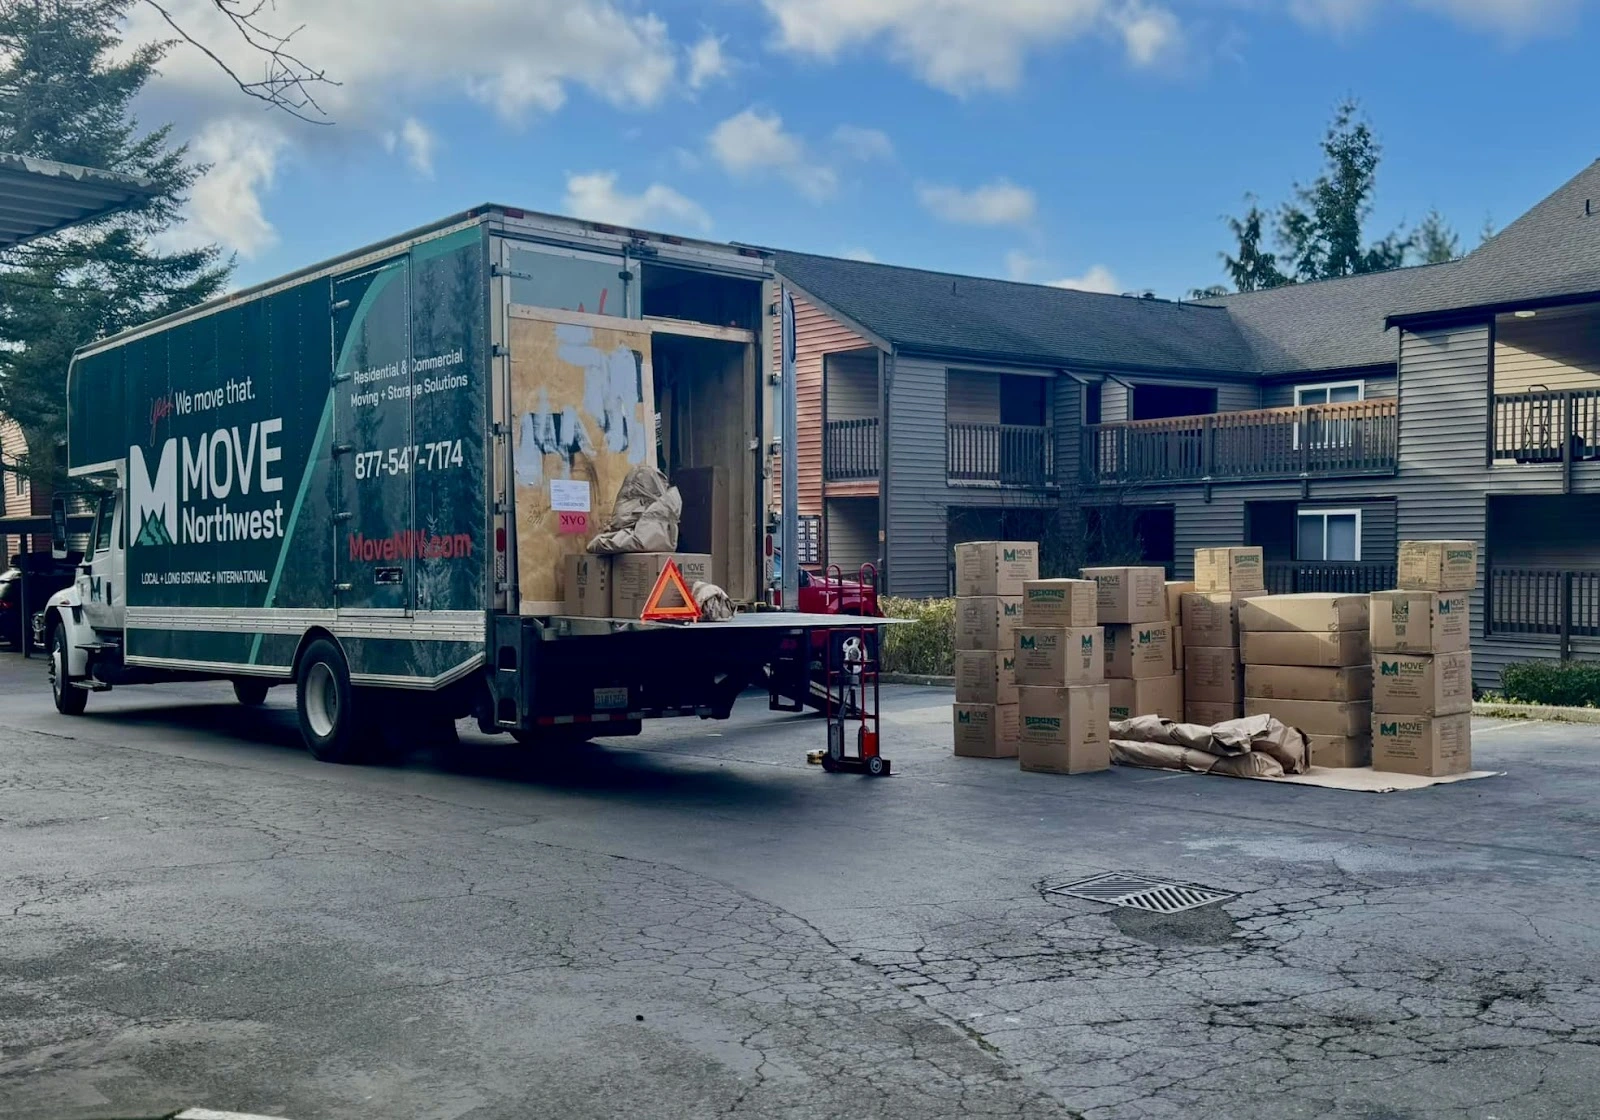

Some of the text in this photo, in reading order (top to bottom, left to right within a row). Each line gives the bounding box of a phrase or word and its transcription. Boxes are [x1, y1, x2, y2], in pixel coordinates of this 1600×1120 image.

[353, 347, 464, 385] Residential & Commercial
[175, 375, 256, 416] We move that.
[350, 390, 379, 407] Moving
[387, 383, 423, 400] Storage
[424, 373, 469, 394] Solutions
[182, 417, 283, 502] MOVE
[355, 438, 464, 480] 877-547-7174
[182, 500, 284, 545] Northwest
[141, 572, 160, 585] LOCAL
[164, 572, 181, 585] LONG
[181, 571, 211, 584] DISTANCE
[216, 570, 269, 584] INTERNATIONAL
[1400, 662, 1424, 670] MOVE
[1398, 722, 1423, 731] MOVE
